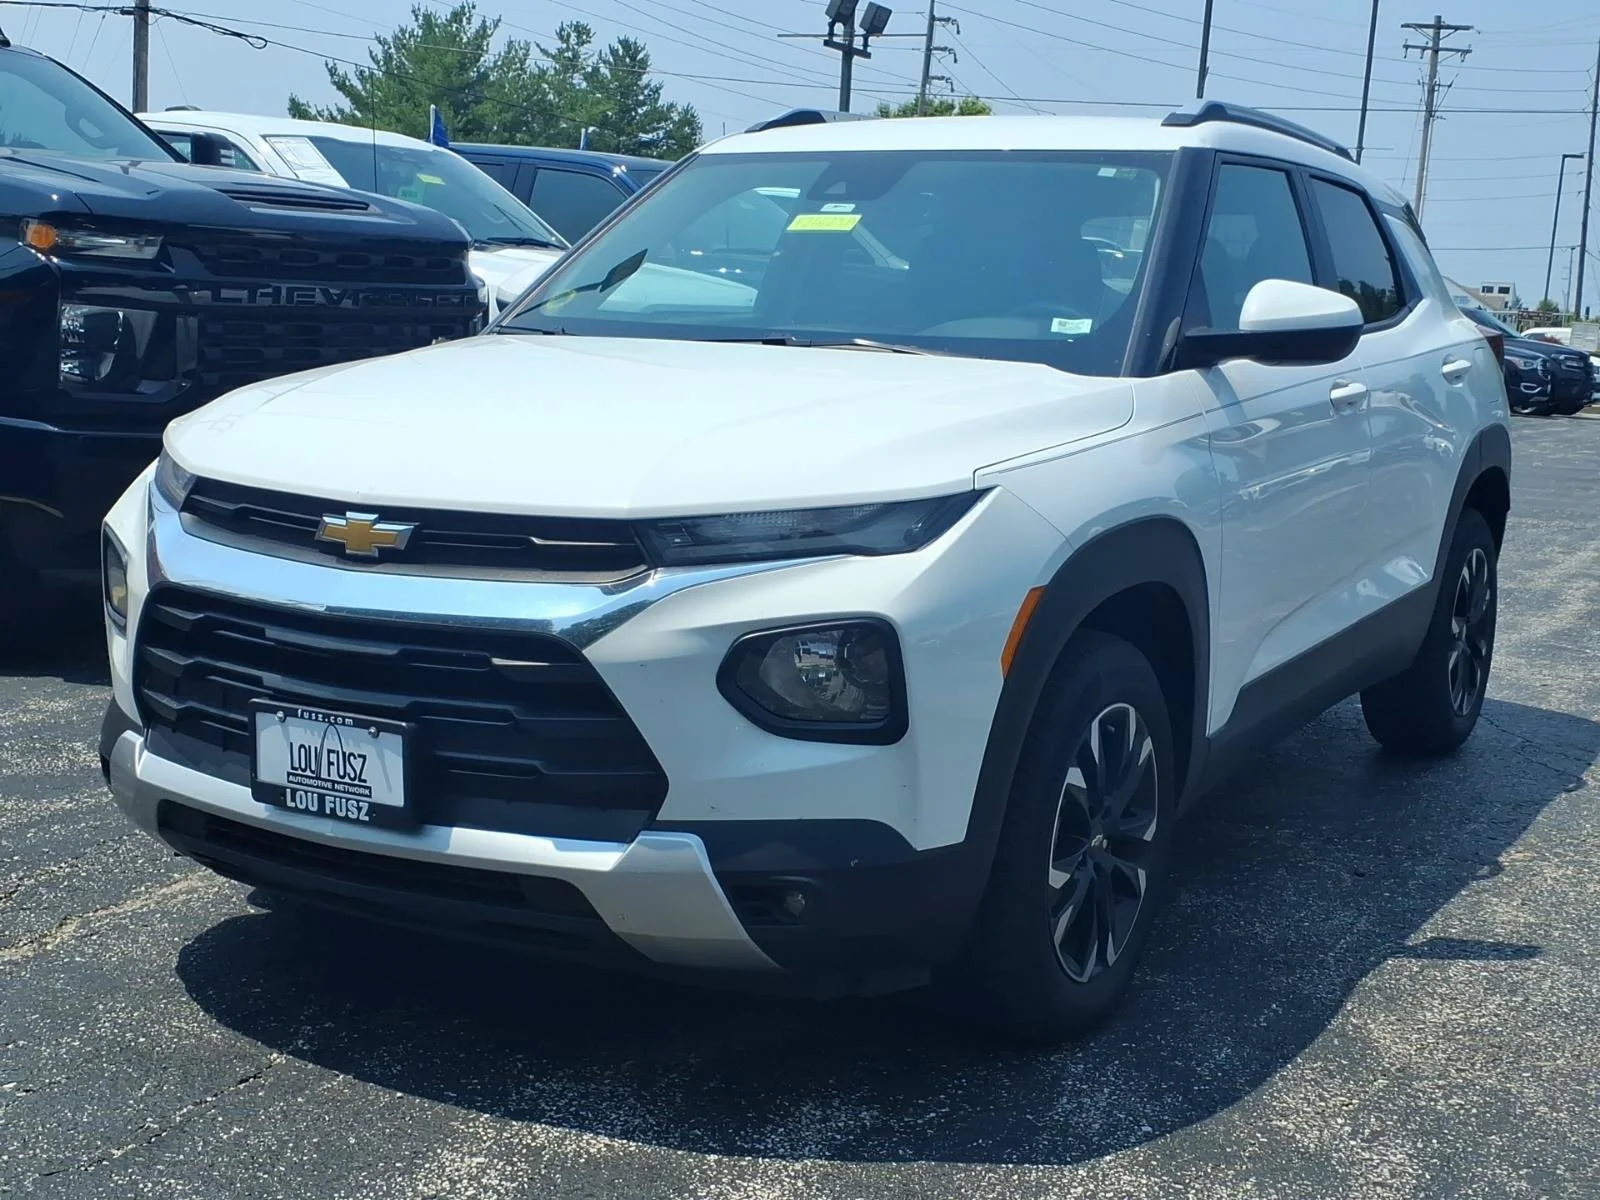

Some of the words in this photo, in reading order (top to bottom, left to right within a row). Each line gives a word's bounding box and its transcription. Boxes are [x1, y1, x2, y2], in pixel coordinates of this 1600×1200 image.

[298, 709, 353, 726] fusz.com
[290, 742, 318, 774] LOU
[327, 748, 367, 784] FUSZ
[288, 774, 332, 790] AUTOMOTIVE
[334, 783, 370, 796] NETWORK
[286, 788, 318, 812] LOU
[325, 796, 370, 821] FUSZ
